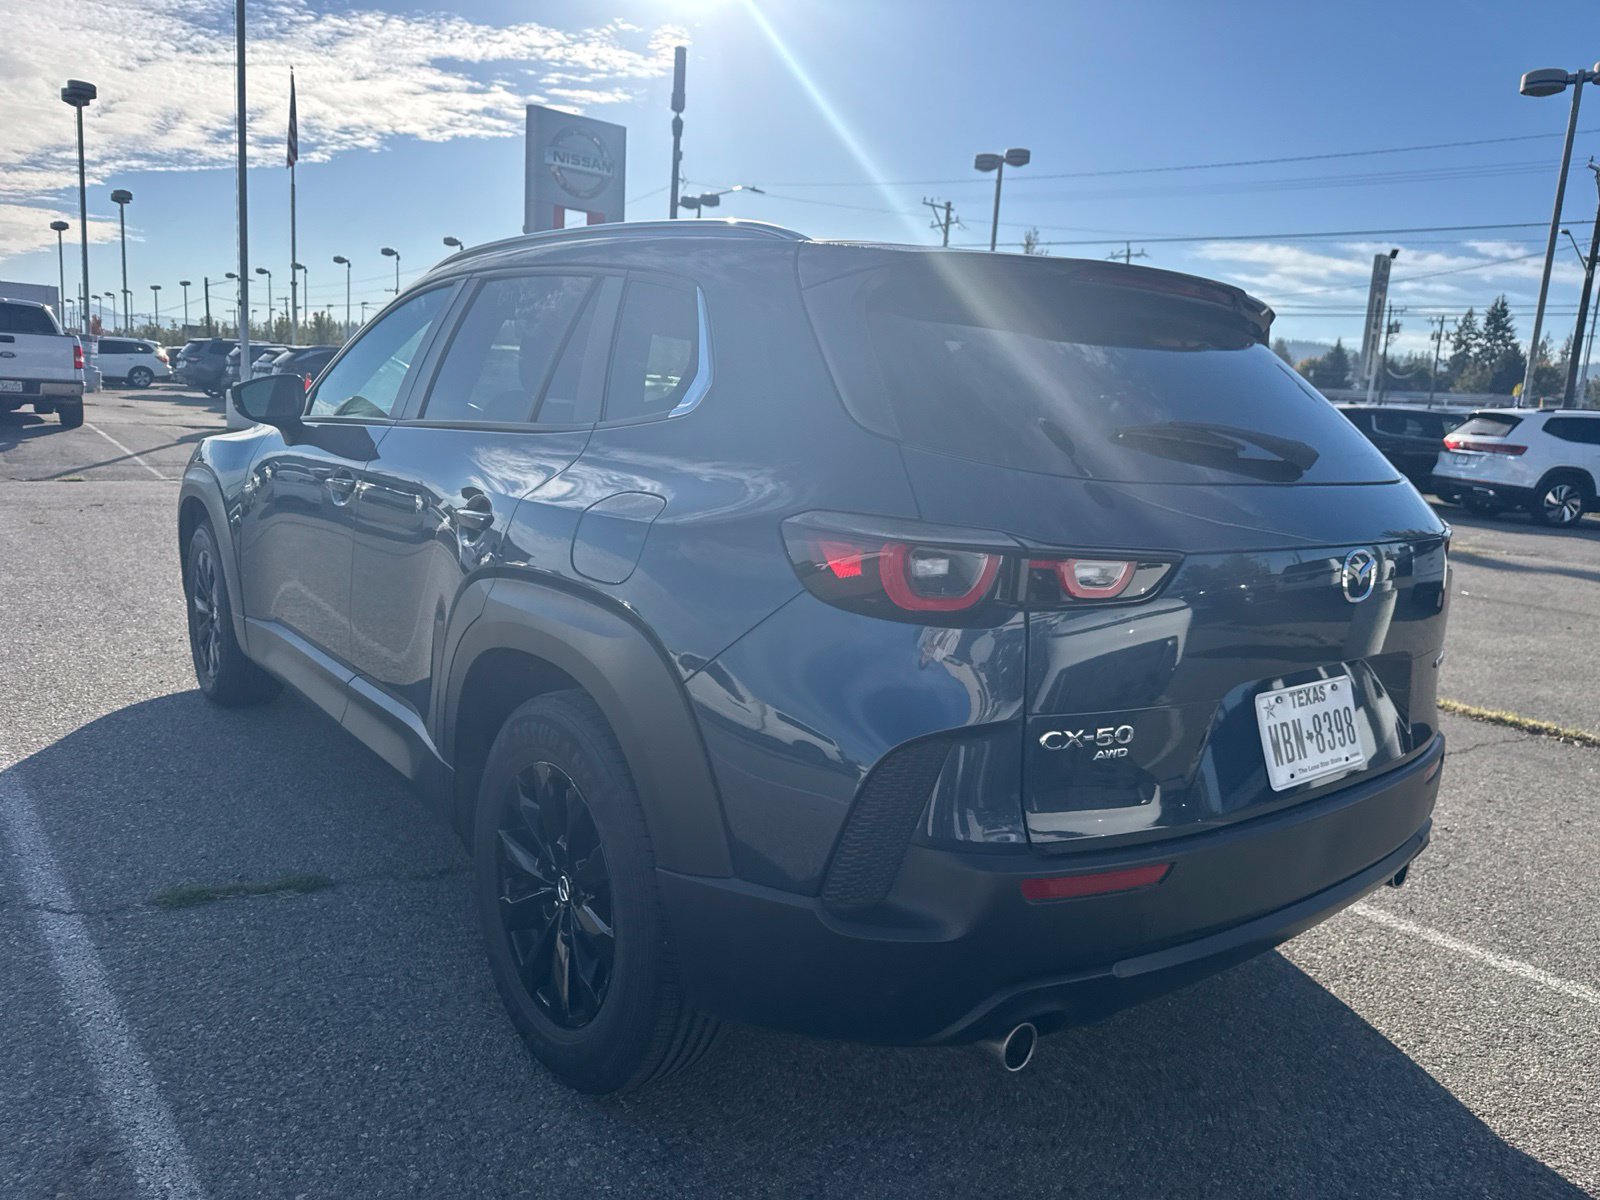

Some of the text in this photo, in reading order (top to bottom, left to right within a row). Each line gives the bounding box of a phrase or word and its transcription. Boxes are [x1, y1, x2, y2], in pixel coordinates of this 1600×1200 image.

[553, 150, 613, 173] NISSAN
[1289, 686, 1326, 708] TEXAS
[1039, 725, 1134, 749] CX-50
[1093, 748, 1128, 760] AWD
